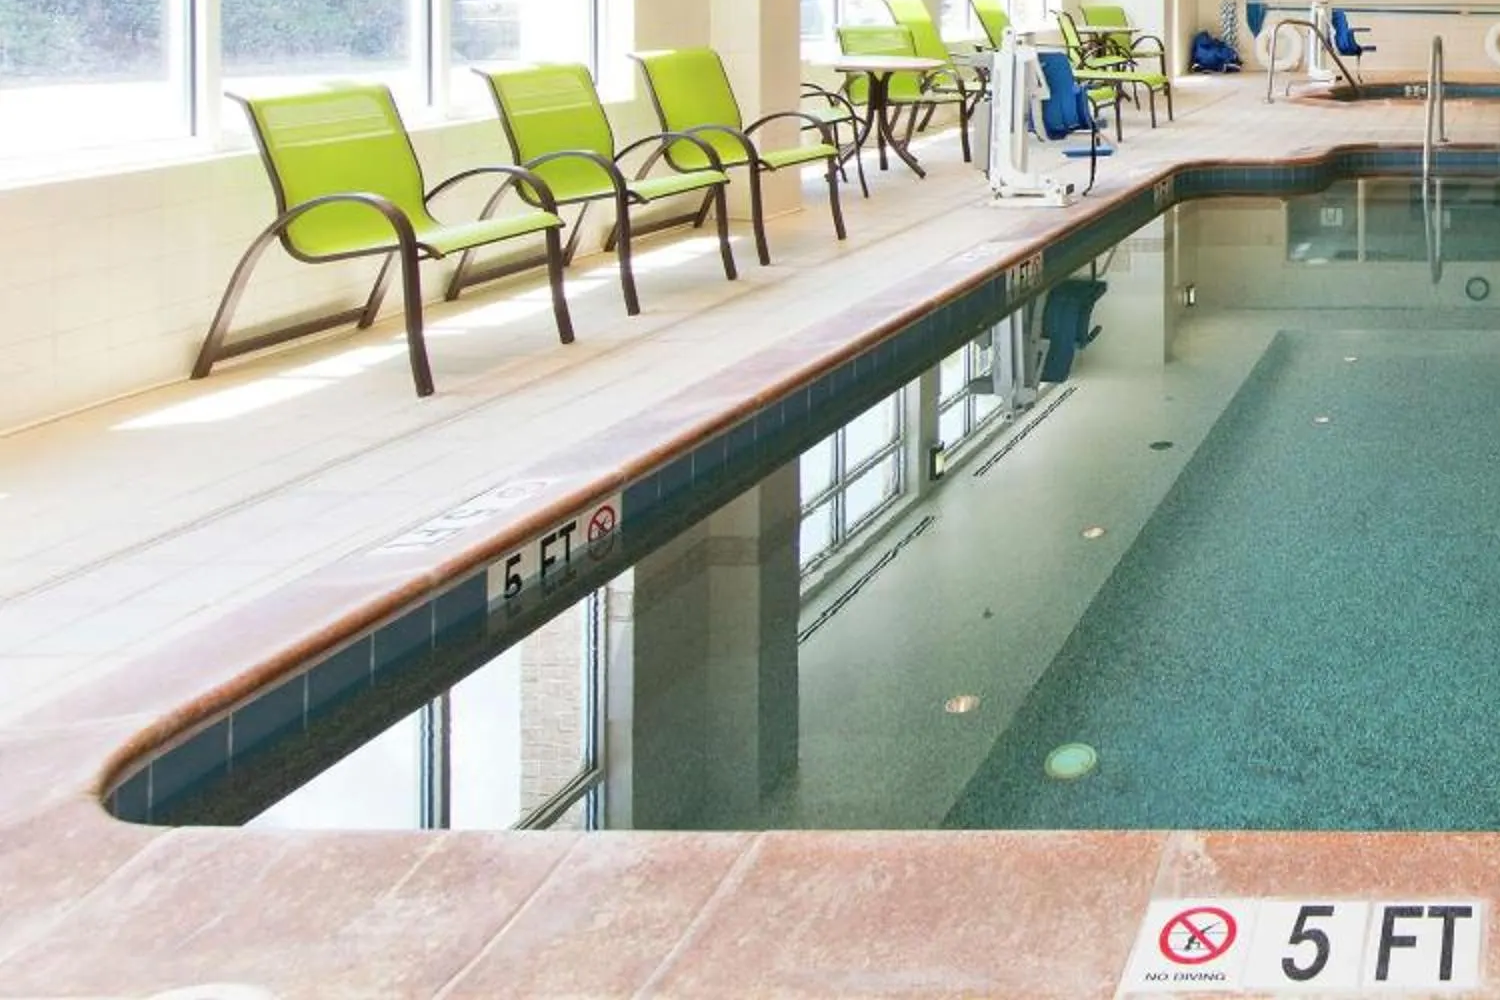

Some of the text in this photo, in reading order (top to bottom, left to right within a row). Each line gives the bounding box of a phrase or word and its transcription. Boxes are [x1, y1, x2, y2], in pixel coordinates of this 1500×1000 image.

[504, 520, 576, 599] 5 FT
[1145, 972, 1227, 981] NO DIVING
[1281, 905, 1473, 982] 5 FT
